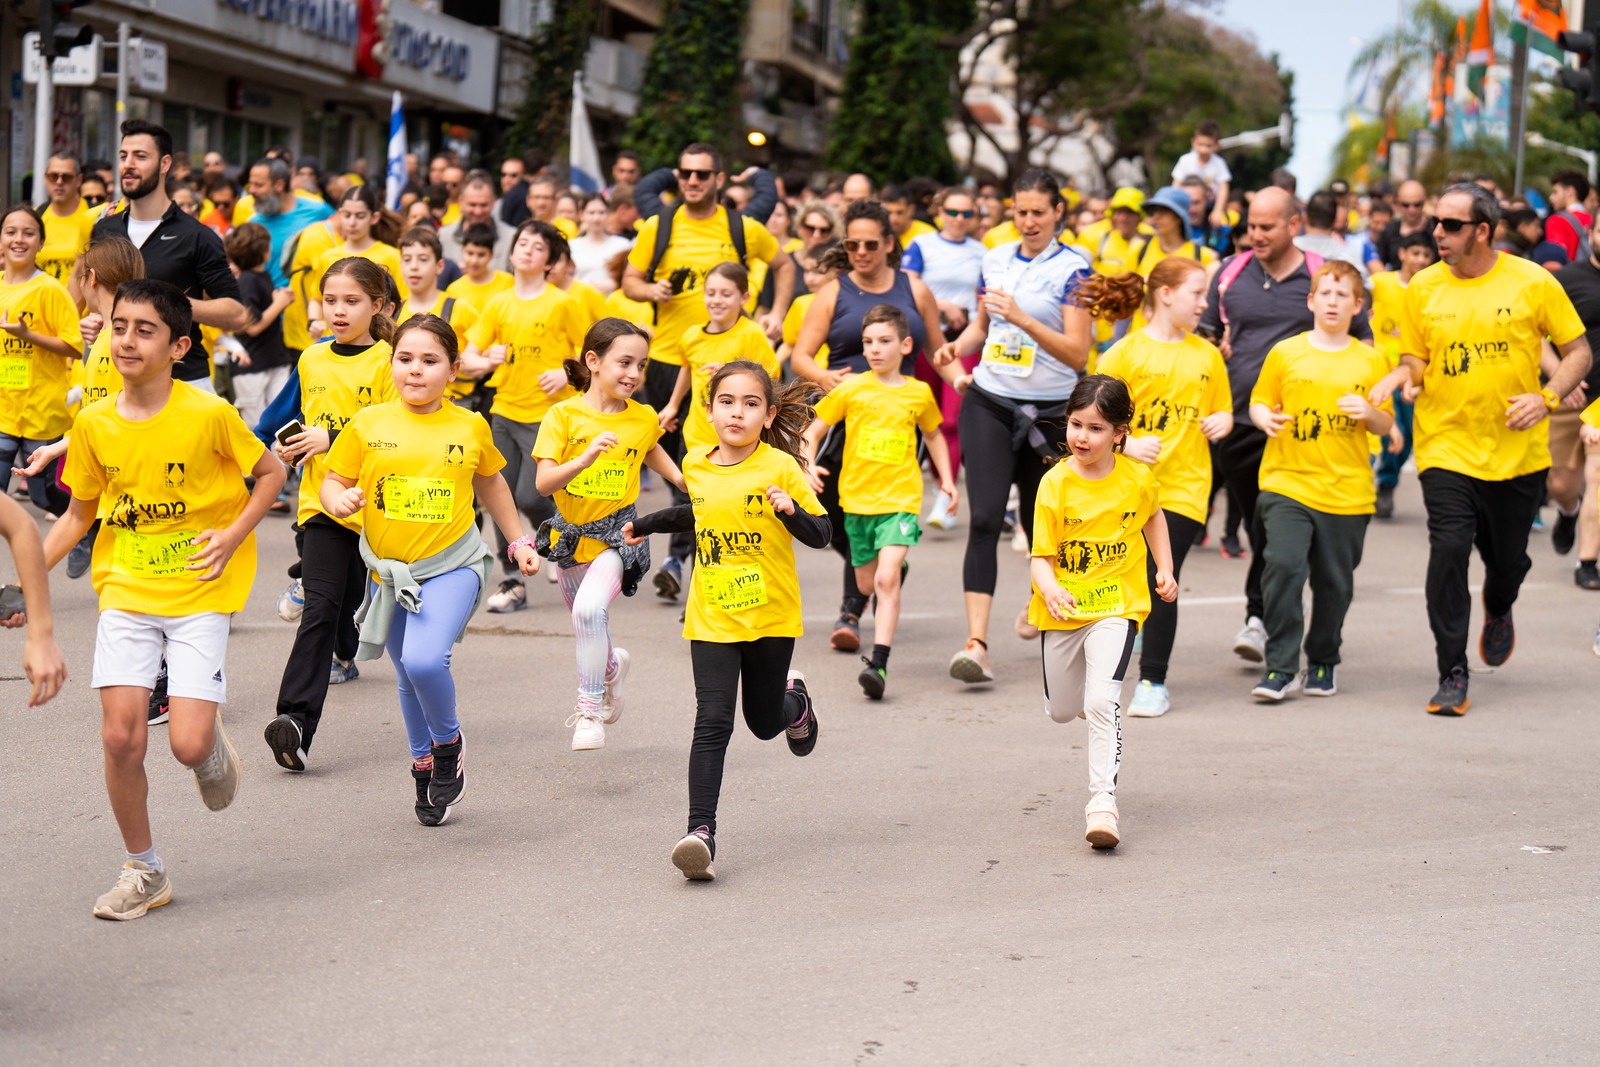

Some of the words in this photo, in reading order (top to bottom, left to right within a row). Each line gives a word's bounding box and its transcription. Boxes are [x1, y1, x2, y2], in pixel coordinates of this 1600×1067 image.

[1474, 341, 1509, 359] מרוץ
[604, 469, 625, 480] מרוץ
[427, 488, 451, 501] מרוץ
[139, 501, 186, 520] מרוץ
[722, 532, 762, 551] מרוץ
[1095, 541, 1127, 562] מרוץ
[734, 573, 760, 588] מרוץ
[1095, 584, 1118, 598] מרוץ
[750, 597, 760, 605] 2.5
